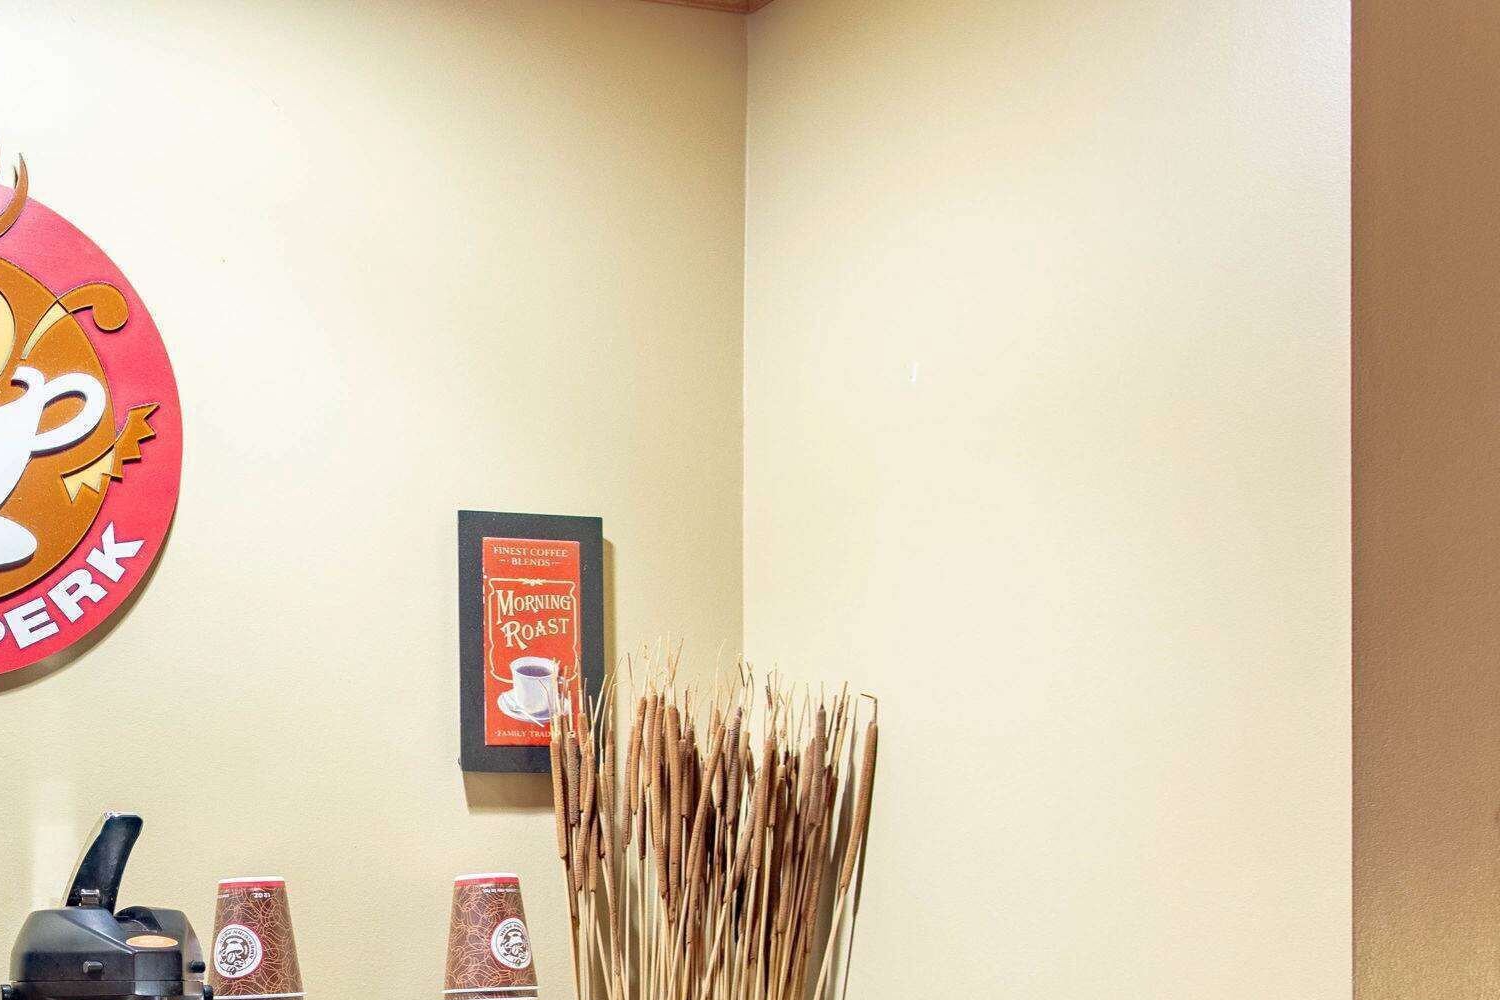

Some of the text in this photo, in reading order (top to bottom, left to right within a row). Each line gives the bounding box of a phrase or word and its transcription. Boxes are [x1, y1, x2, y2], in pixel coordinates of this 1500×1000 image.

[493, 545, 568, 557] FINEST COFFEE
[512, 557, 550, 566] BLENDS
[496, 589, 572, 624] MORNING
[501, 618, 570, 650] ROAST
